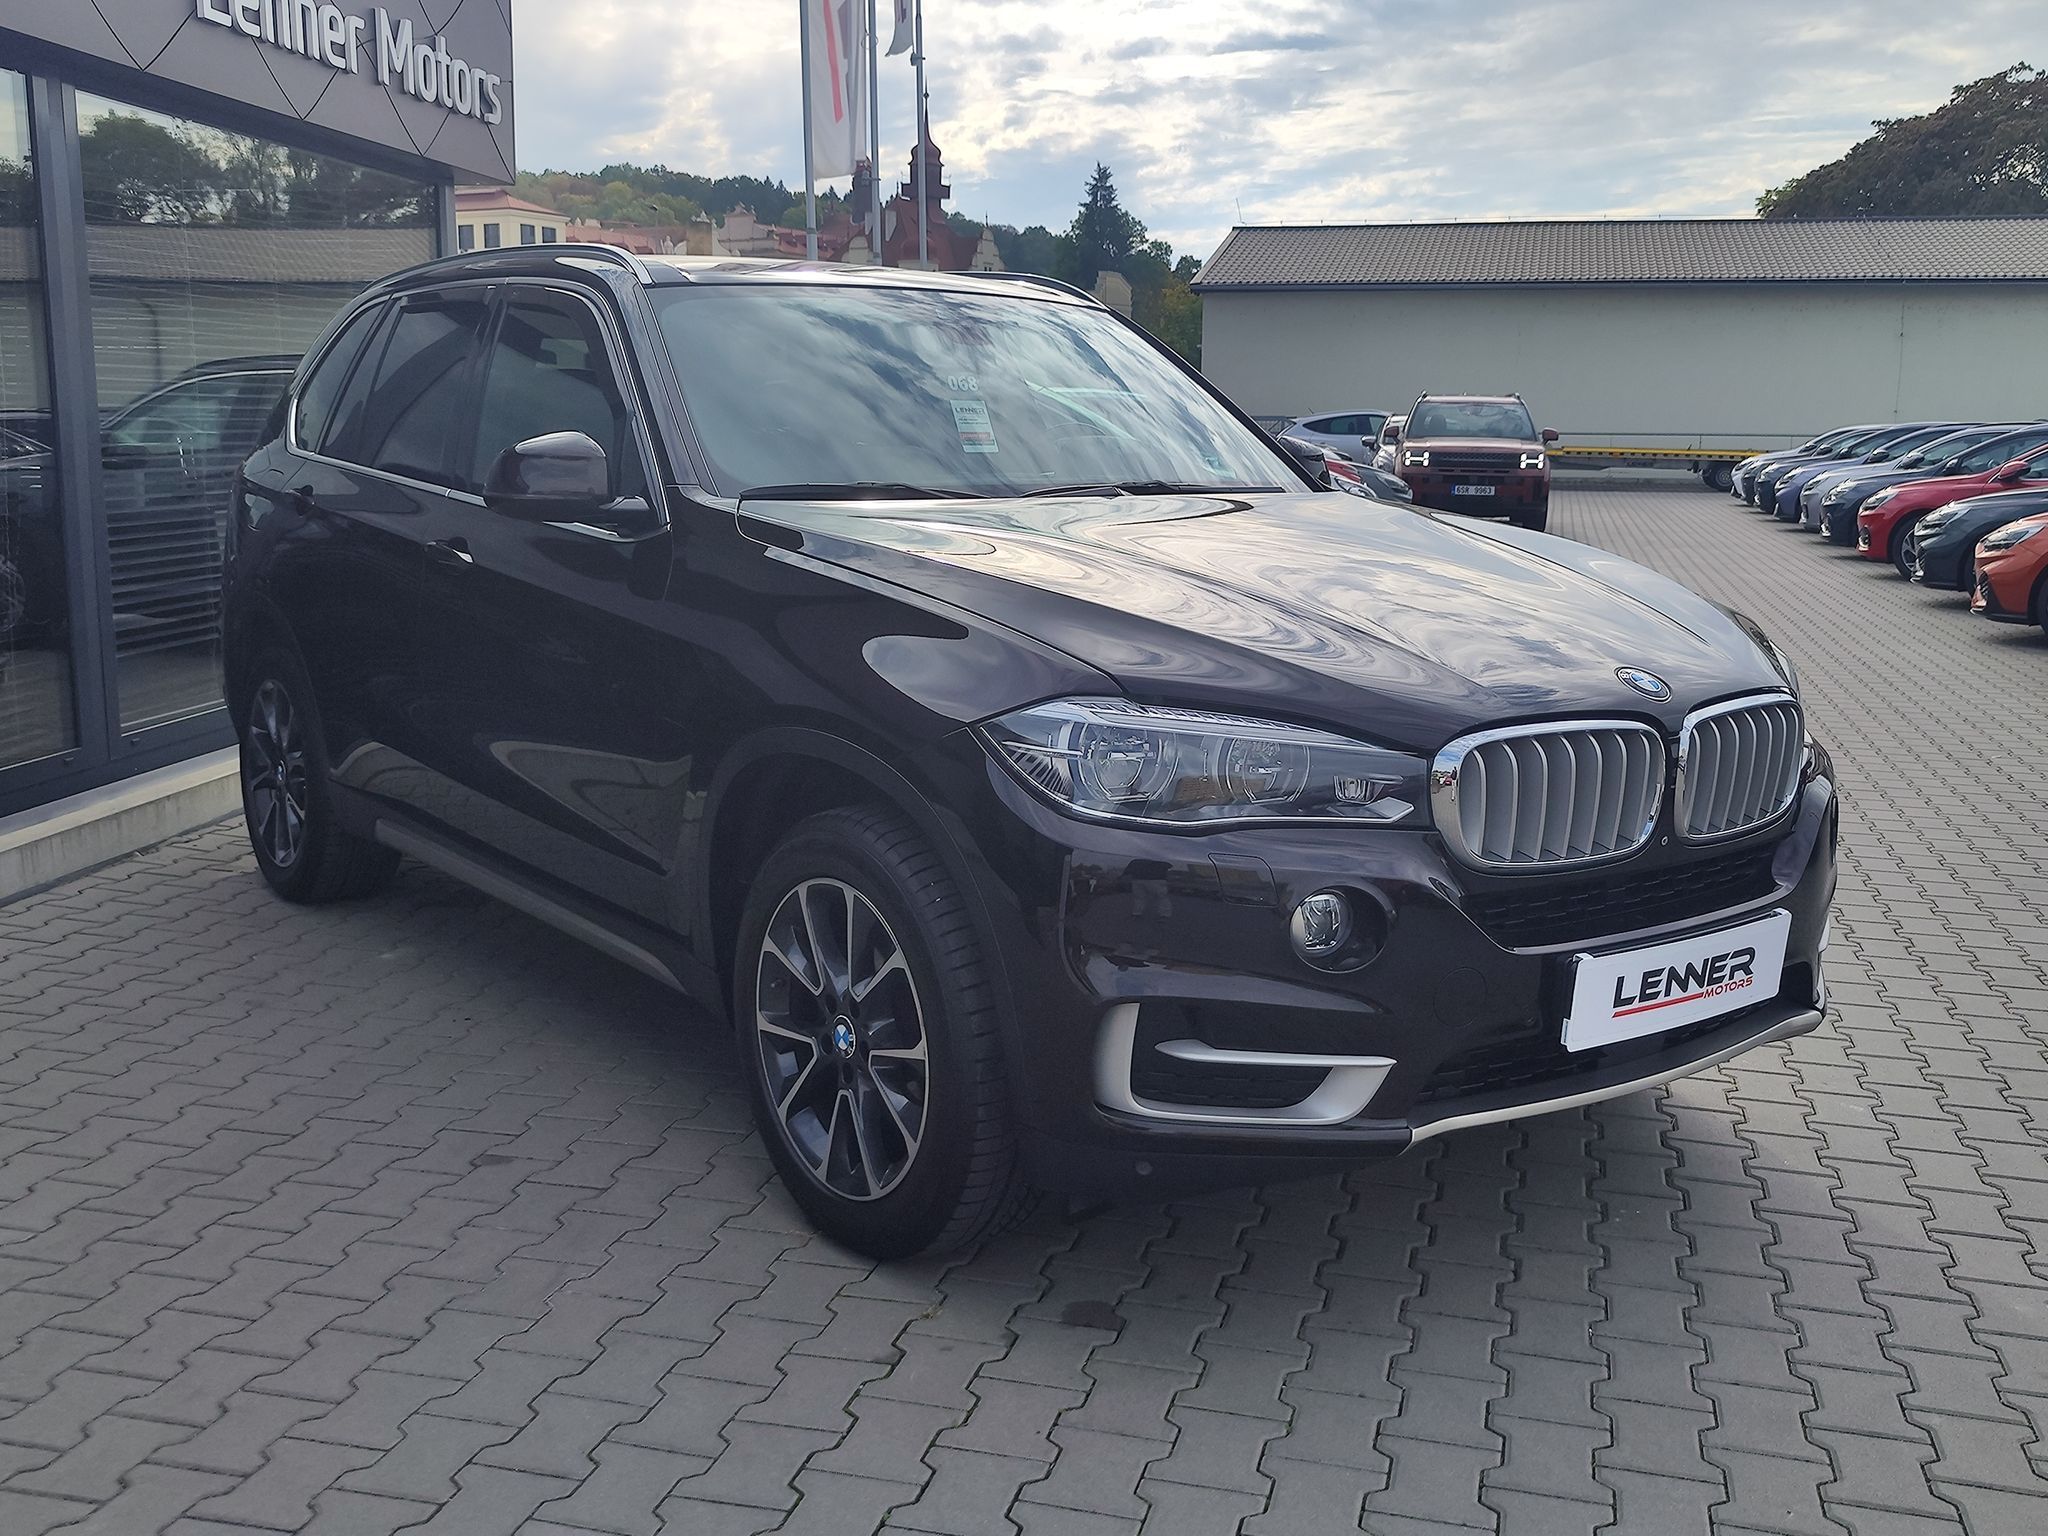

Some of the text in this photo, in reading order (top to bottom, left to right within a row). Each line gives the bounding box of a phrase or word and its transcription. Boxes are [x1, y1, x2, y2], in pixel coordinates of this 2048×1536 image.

[372, 7, 503, 126] Motors
[948, 375, 979, 392] 068
[1612, 946, 1756, 1009] LENNER
[1703, 976, 1754, 999] MOTORS
